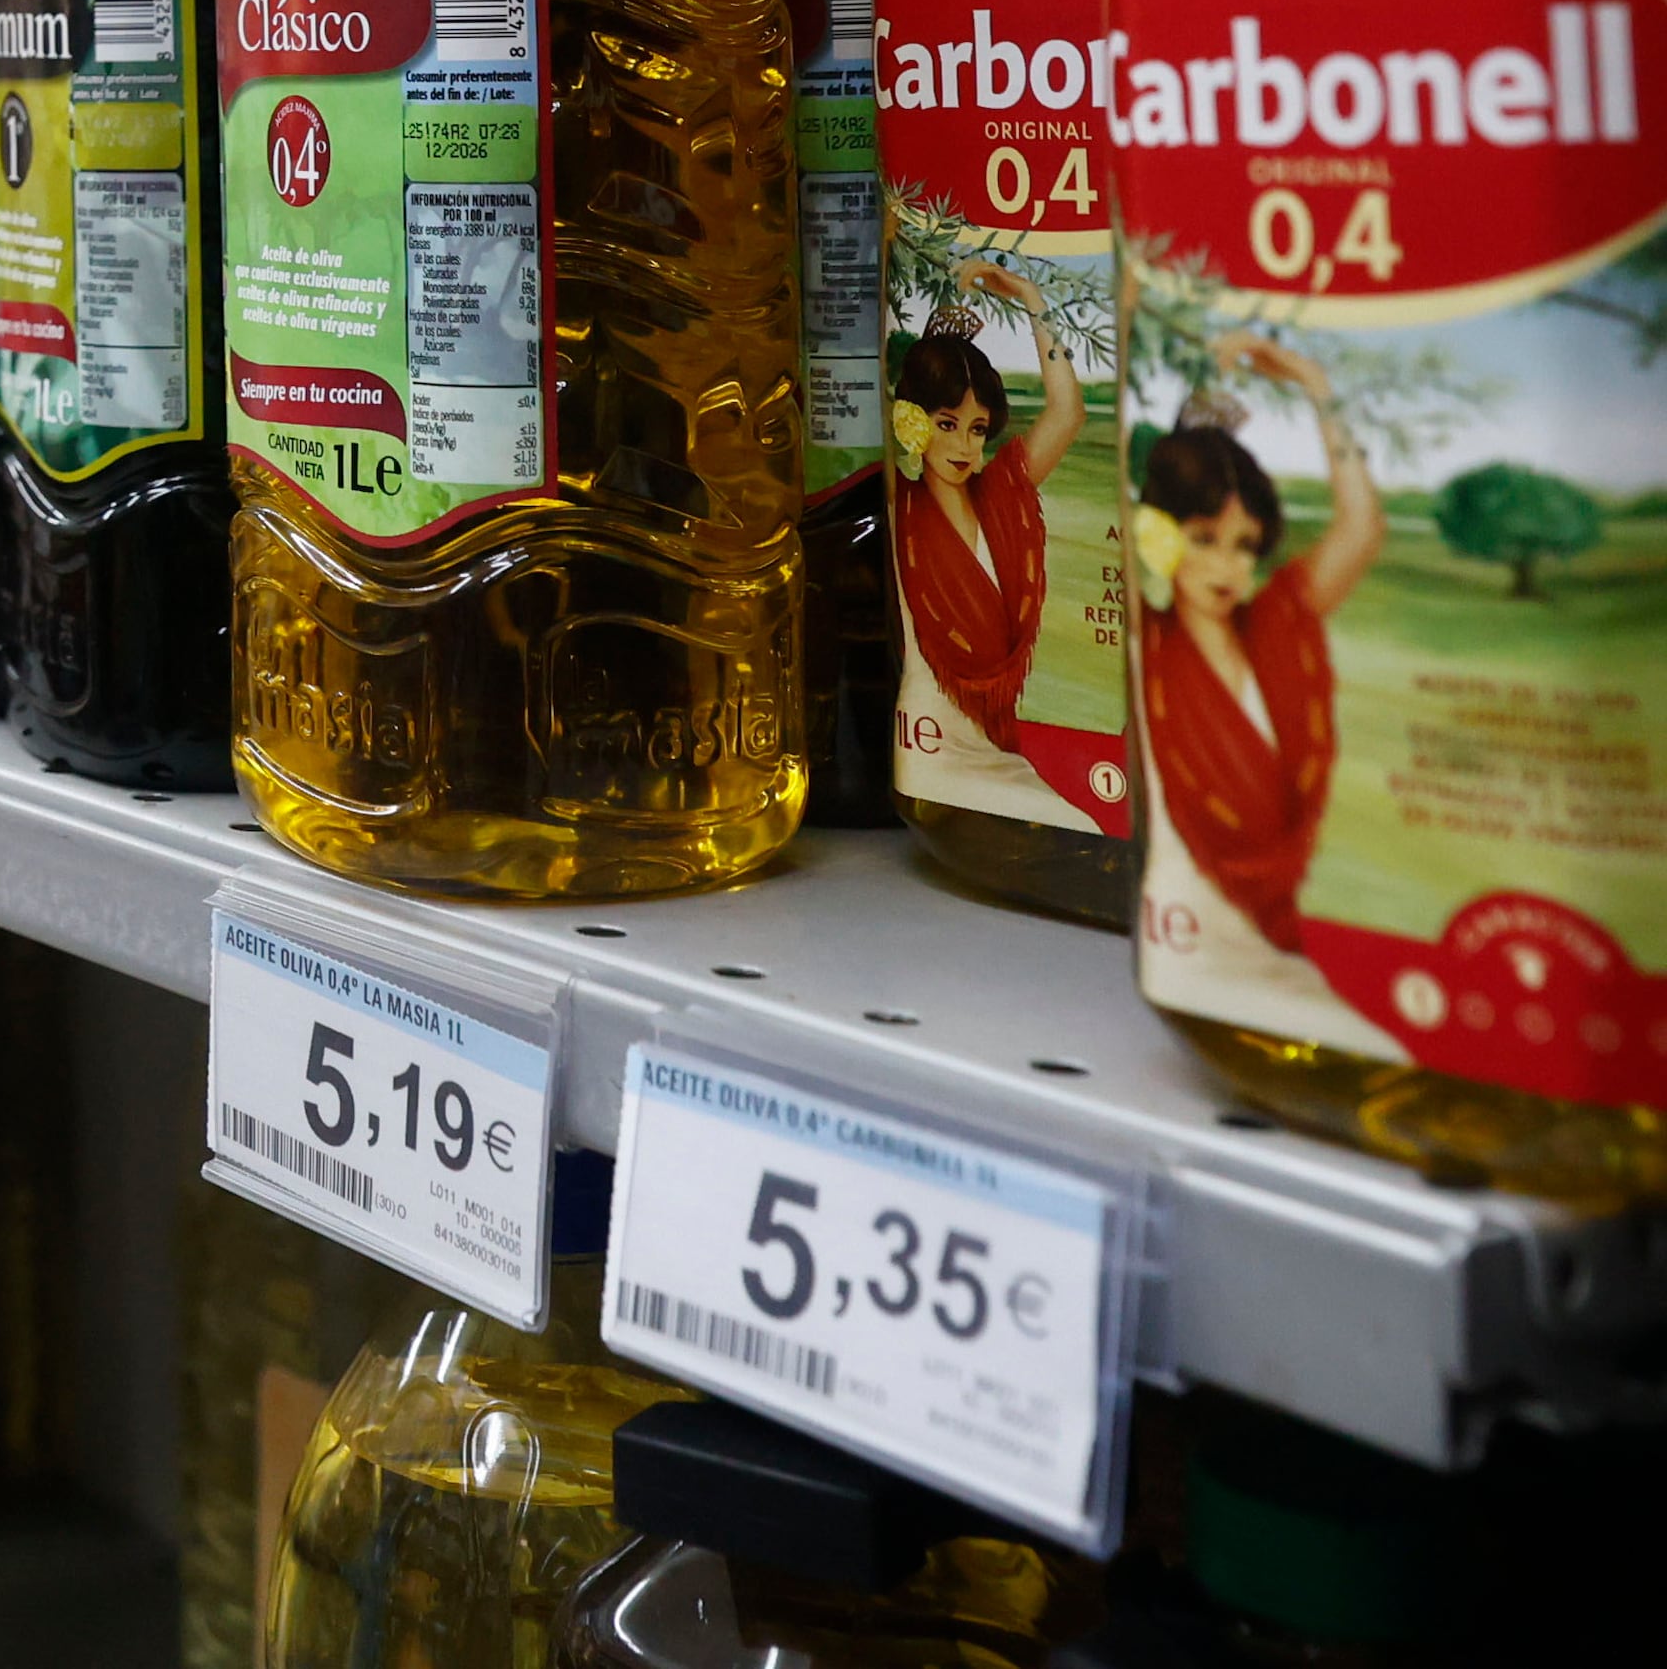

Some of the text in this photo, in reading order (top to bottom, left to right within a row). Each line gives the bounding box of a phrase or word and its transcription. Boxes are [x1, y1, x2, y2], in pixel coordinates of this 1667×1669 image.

[406, 70, 532, 85] Consumir preferentemente
[1107, 0, 1640, 149] Carbonell
[407, 88, 427, 100] antes
[430, 88, 444, 100] del
[448, 87, 461, 100] fin
[985, 121, 1092, 141] ORIGINAL
[426, 142, 488, 158] 12/2026
[986, 146, 1098, 226] 0,4
[411, 191, 532, 207] INFORMACIÓN NUTRICIONAL
[443, 209, 496, 222] POR 100 ml
[1249, 187, 1403, 295] 0,4
[261, 245, 343, 268] Aceite de oliva
[234, 265, 390, 294] que contiene exclusivamente
[237, 284, 387, 320] aceites de oliva refinados y
[242, 307, 376, 338] aceites de oliva vírgenes
[240, 378, 383, 405] Siempre en tu cocina
[267, 433, 324, 458] CANTIDAD
[295, 460, 324, 481] NETA
[1095, 628, 1118, 646] DE
[225, 925, 276, 963] ACEITE
[280, 947, 323, 985] OLIVA
[363, 982, 383, 1010] LA
[387, 992, 441, 1035] MASIA
[447, 1018, 464, 1045] 1L
[643, 1060, 712, 1103] ACEITE
[719, 1083, 779, 1121] OLIVA
[835, 1118, 965, 1180] CARBONELL
[430, 1181, 521, 1238] L011 M001 014
[455, 1211, 469, 1229] 10
